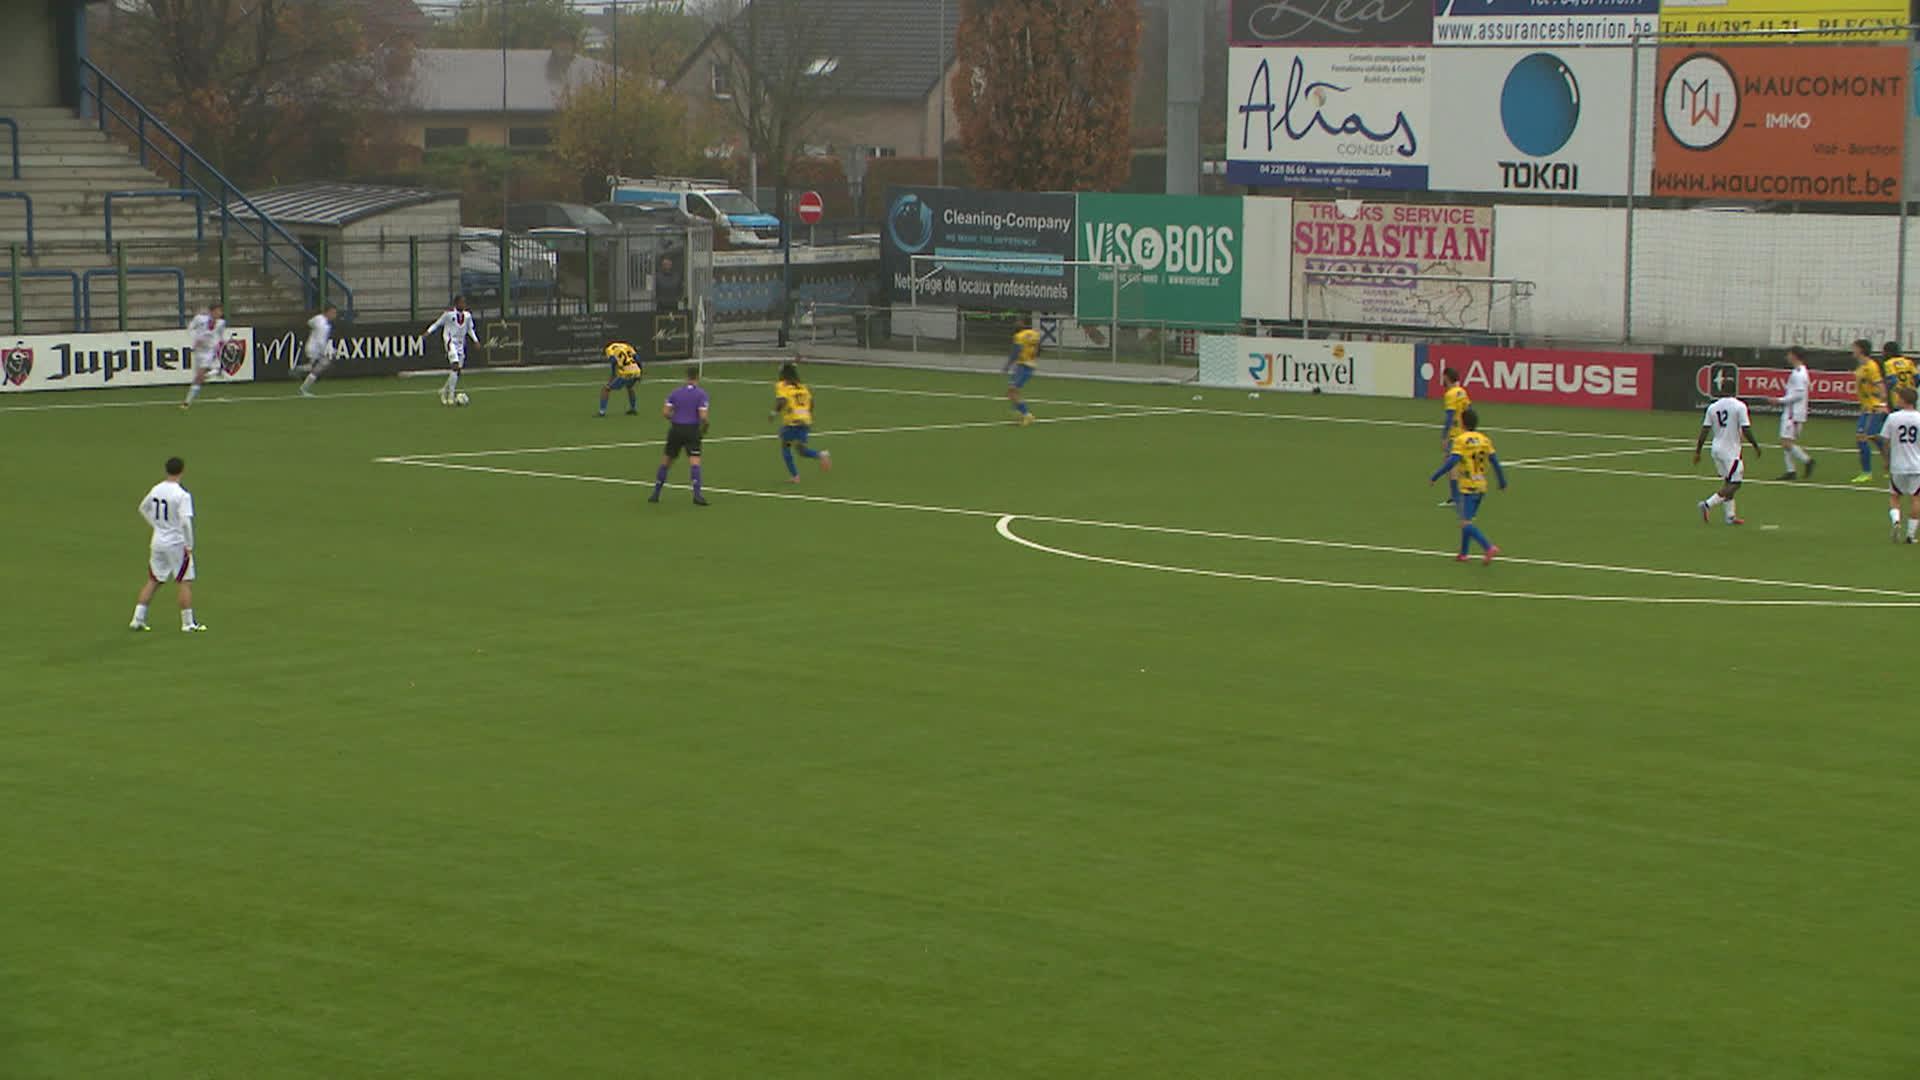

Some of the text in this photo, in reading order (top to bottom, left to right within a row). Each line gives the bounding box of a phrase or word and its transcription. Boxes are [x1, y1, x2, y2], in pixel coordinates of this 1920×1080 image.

[1437, 18, 1653, 40] www.assuranceshenrion.be
[1744, 76, 1903, 97] WAUCOMONT
[1239, 56, 1417, 157] Alias
[1765, 112, 1812, 129] IMMO
[1337, 143, 1395, 156] CONSULT
[1498, 161, 1579, 190] TOKAI
[1656, 168, 1897, 196] www.waucomont.be
[942, 208, 1072, 233] Cleaning-Company
[1393, 208, 1475, 225] SERVICE
[1295, 220, 1490, 262] SEBASTIAN
[894, 272, 1068, 300] Netoyage de locaux professionnels
[1276, 353, 1355, 385] Travel
[1716, 409, 1728, 428] 12
[1898, 424, 1918, 444] 29
[152, 497, 169, 521] 11
